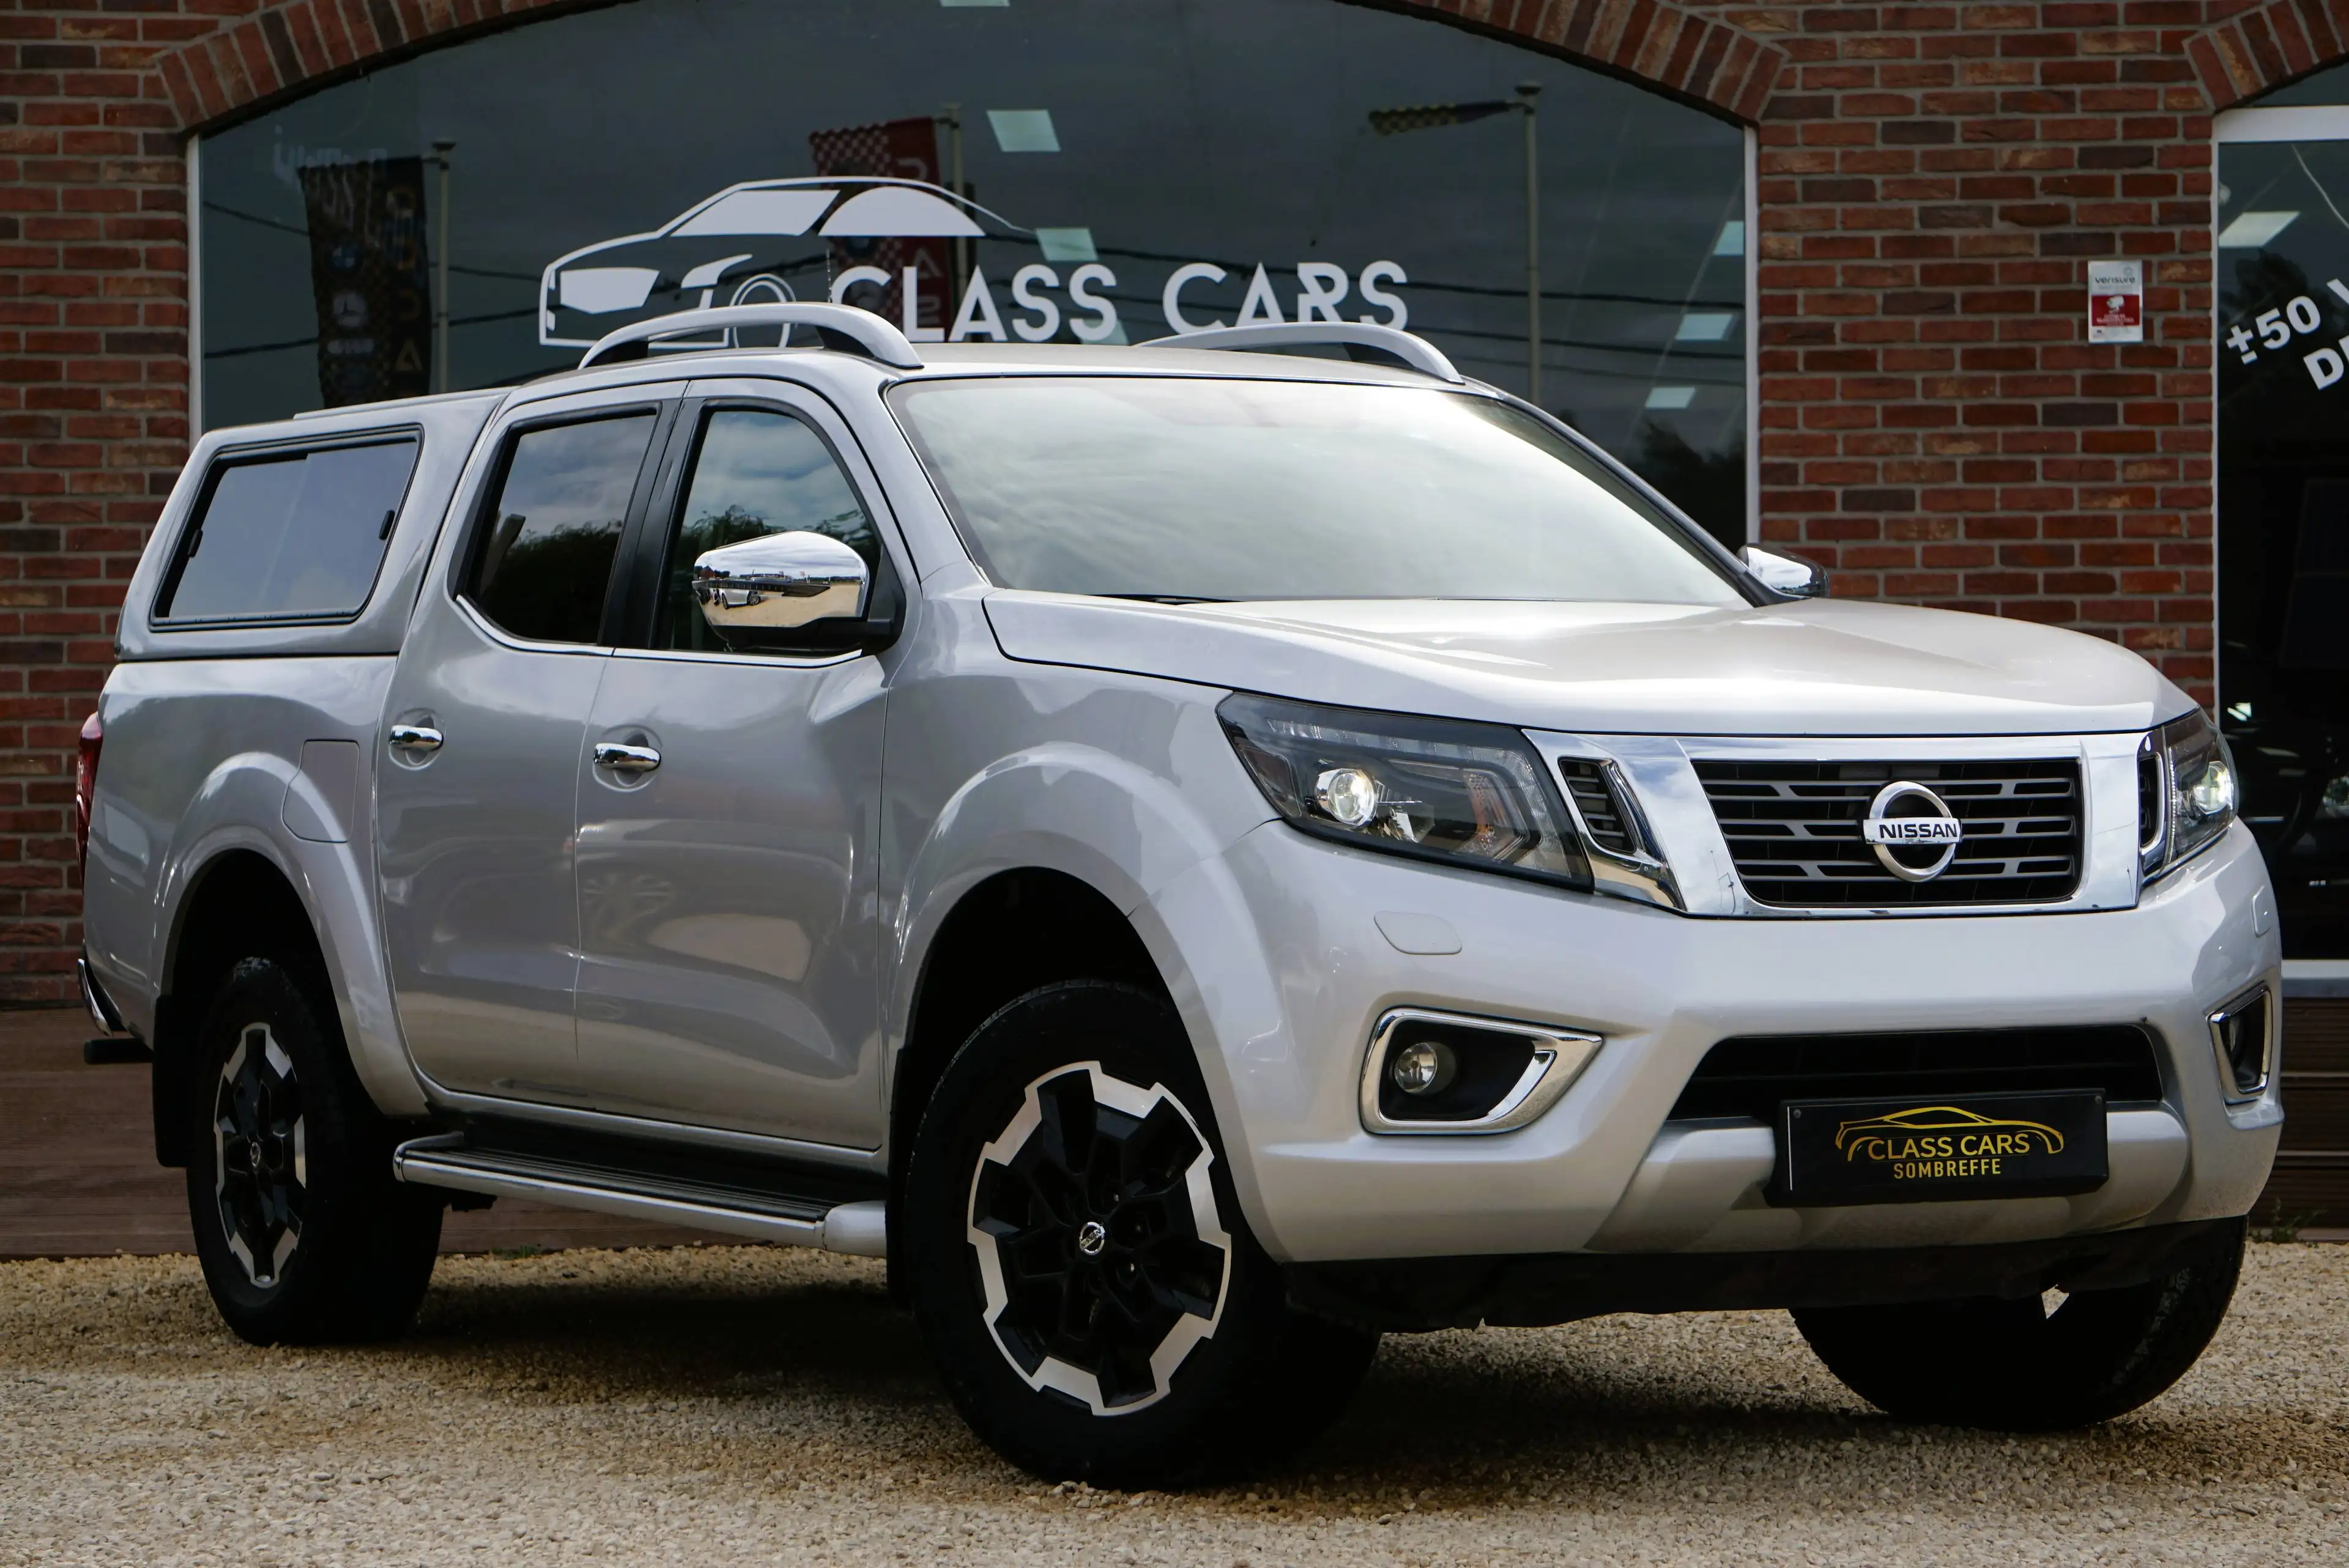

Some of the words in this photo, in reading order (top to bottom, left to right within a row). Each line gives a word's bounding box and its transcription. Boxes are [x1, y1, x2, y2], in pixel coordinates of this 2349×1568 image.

[831, 262, 1117, 342] CLASS
[1162, 260, 1409, 334] CARS
[1879, 823, 1958, 838] NISSAN
[1868, 1137, 1953, 1160] CLASS
[1960, 1133, 2030, 1156] CARS
[1893, 1158, 2002, 1179] SOMBREFFE
